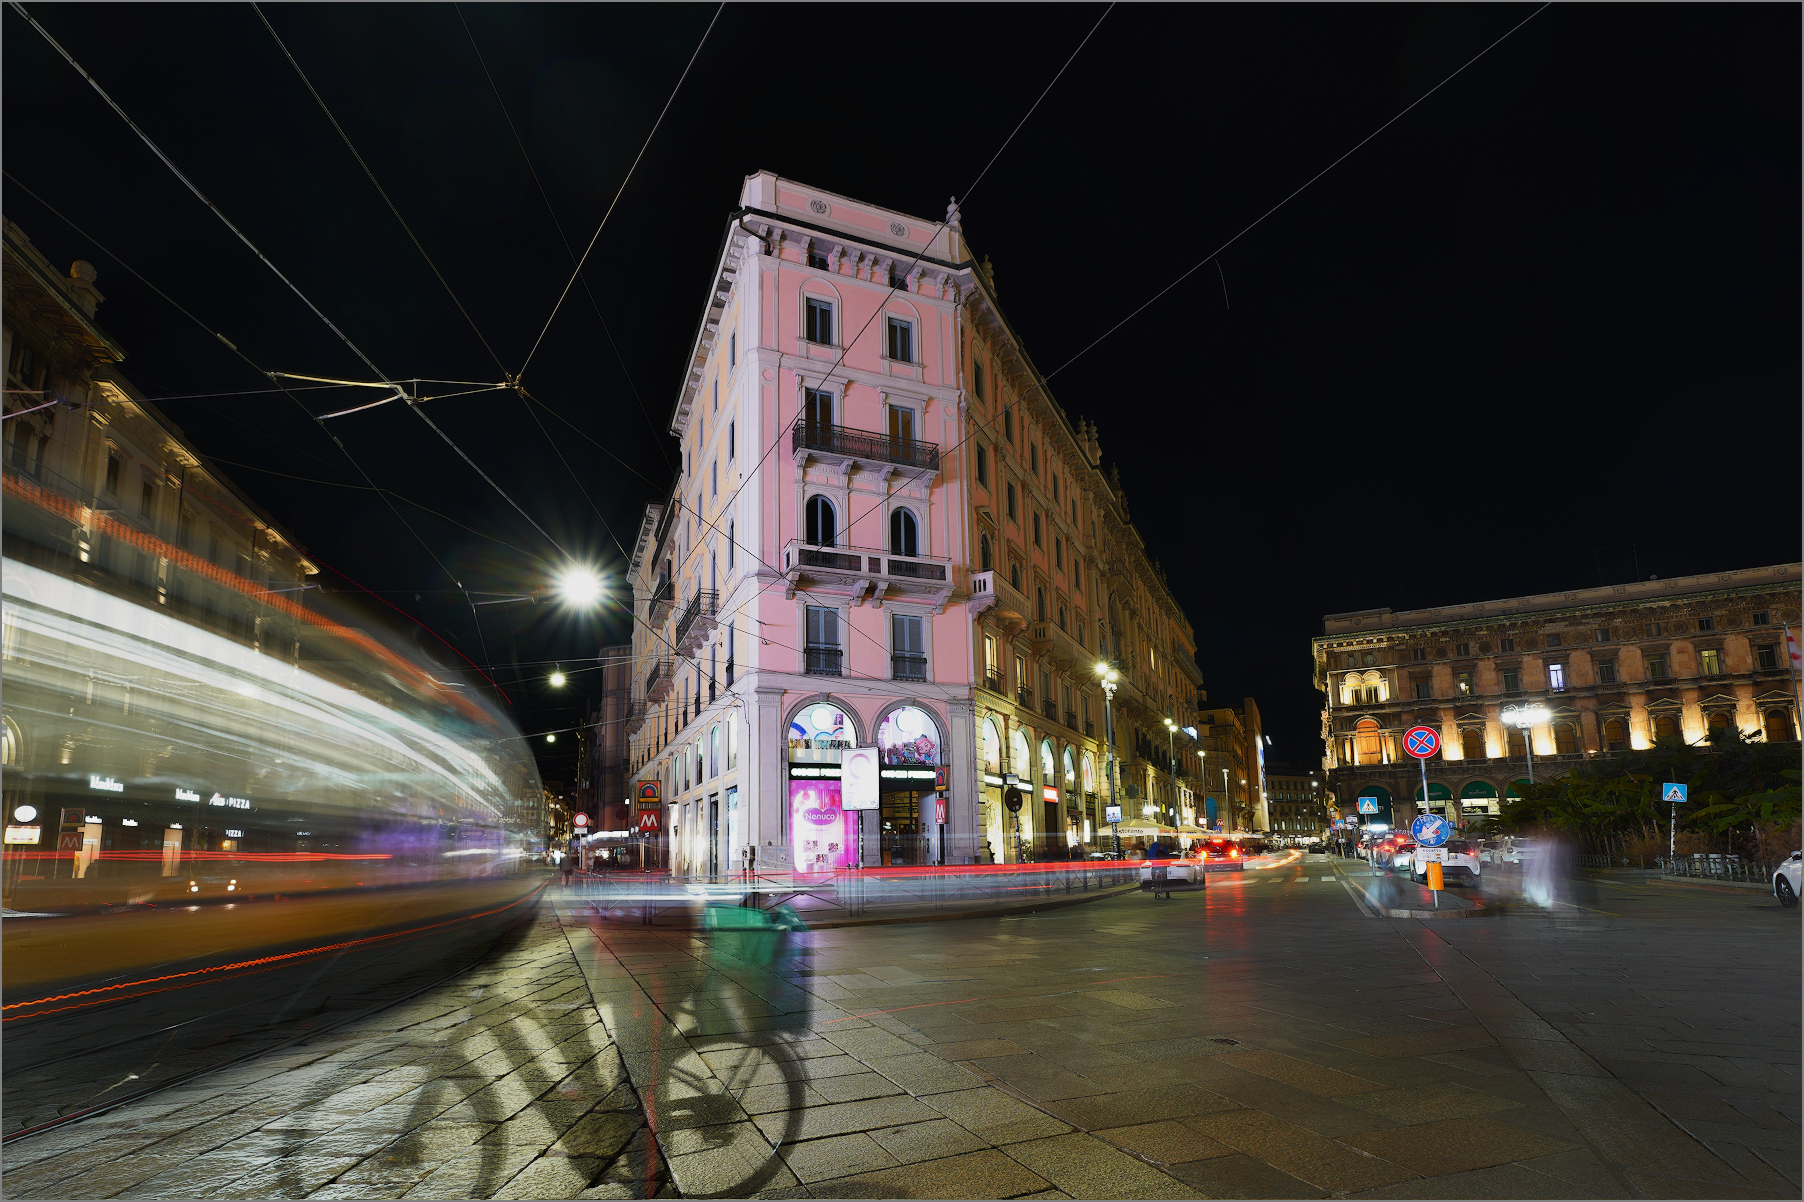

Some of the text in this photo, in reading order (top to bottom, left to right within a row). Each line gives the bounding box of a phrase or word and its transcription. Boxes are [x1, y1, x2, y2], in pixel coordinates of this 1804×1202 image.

[229, 797, 250, 810] PIZZA
[640, 814, 658, 827] M
[805, 812, 835, 820] Nenuco
[61, 836, 79, 848] M
